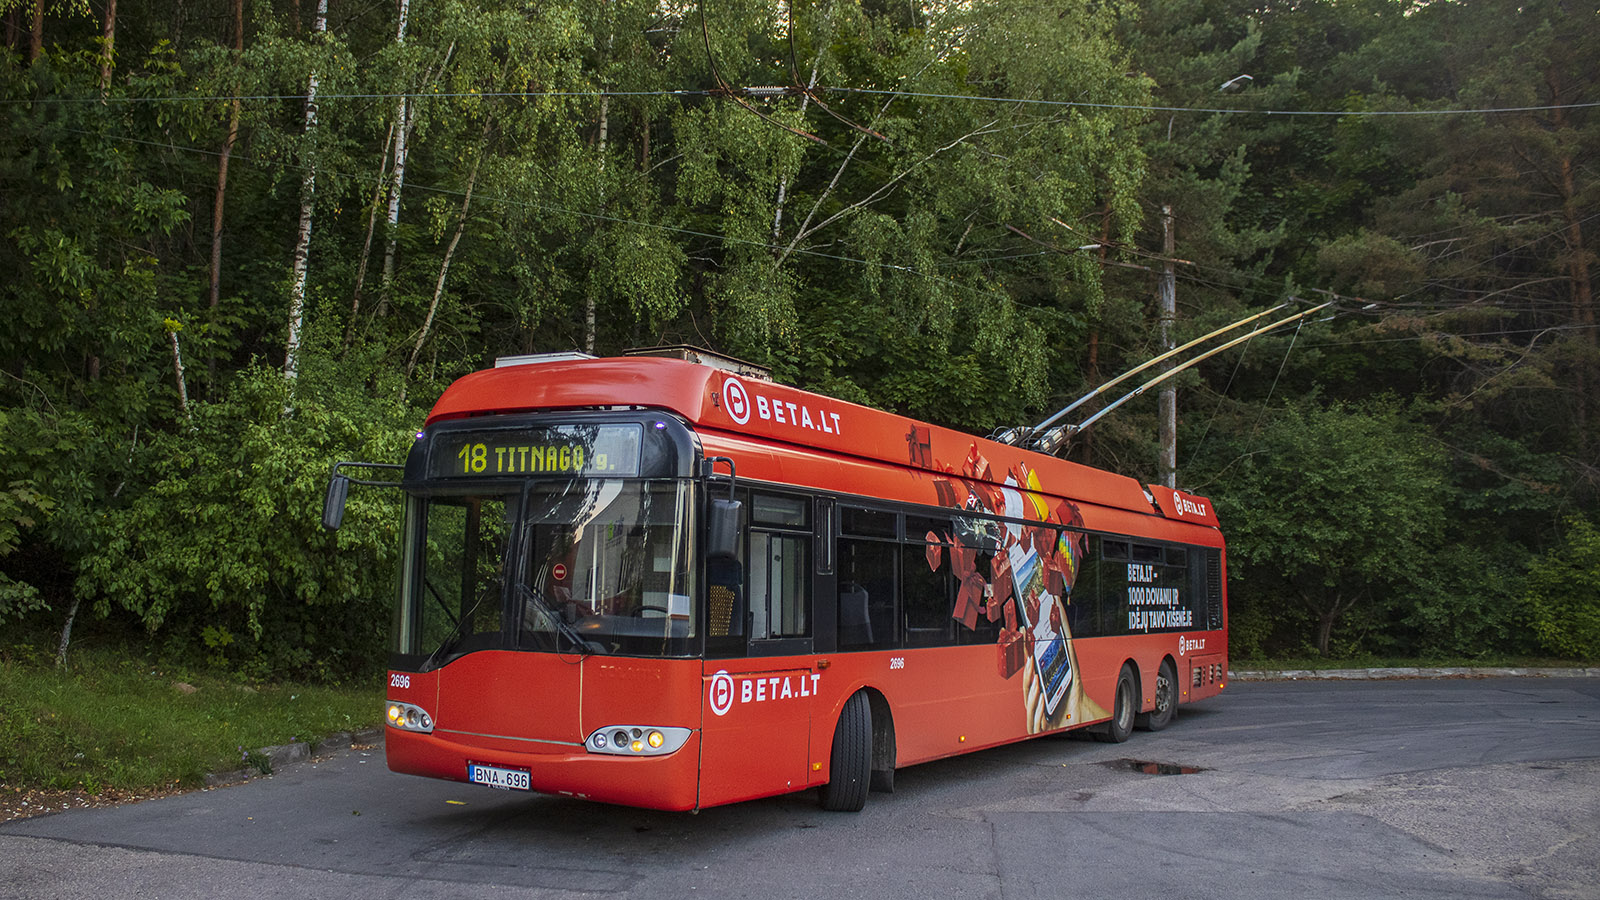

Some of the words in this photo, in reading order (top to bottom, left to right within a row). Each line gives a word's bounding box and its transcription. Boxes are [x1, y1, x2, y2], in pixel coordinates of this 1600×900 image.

[756, 395, 840, 435] BETA.LT
[458, 443, 487, 473] 18
[495, 445, 584, 472] TITNAGO
[596, 454, 615, 470] g.
[1182, 499, 1206, 517] BETA.LT
[1128, 564, 1153, 582] BETA.LT
[1128, 587, 1145, 605] 1000
[1172, 588, 1180, 605] IR
[1149, 611, 1166, 628] TAVO
[1186, 639, 1206, 651] BETA.LT
[890, 657, 904, 670] 2696
[390, 673, 410, 689] 2696
[741, 674, 820, 703] BETA.LT
